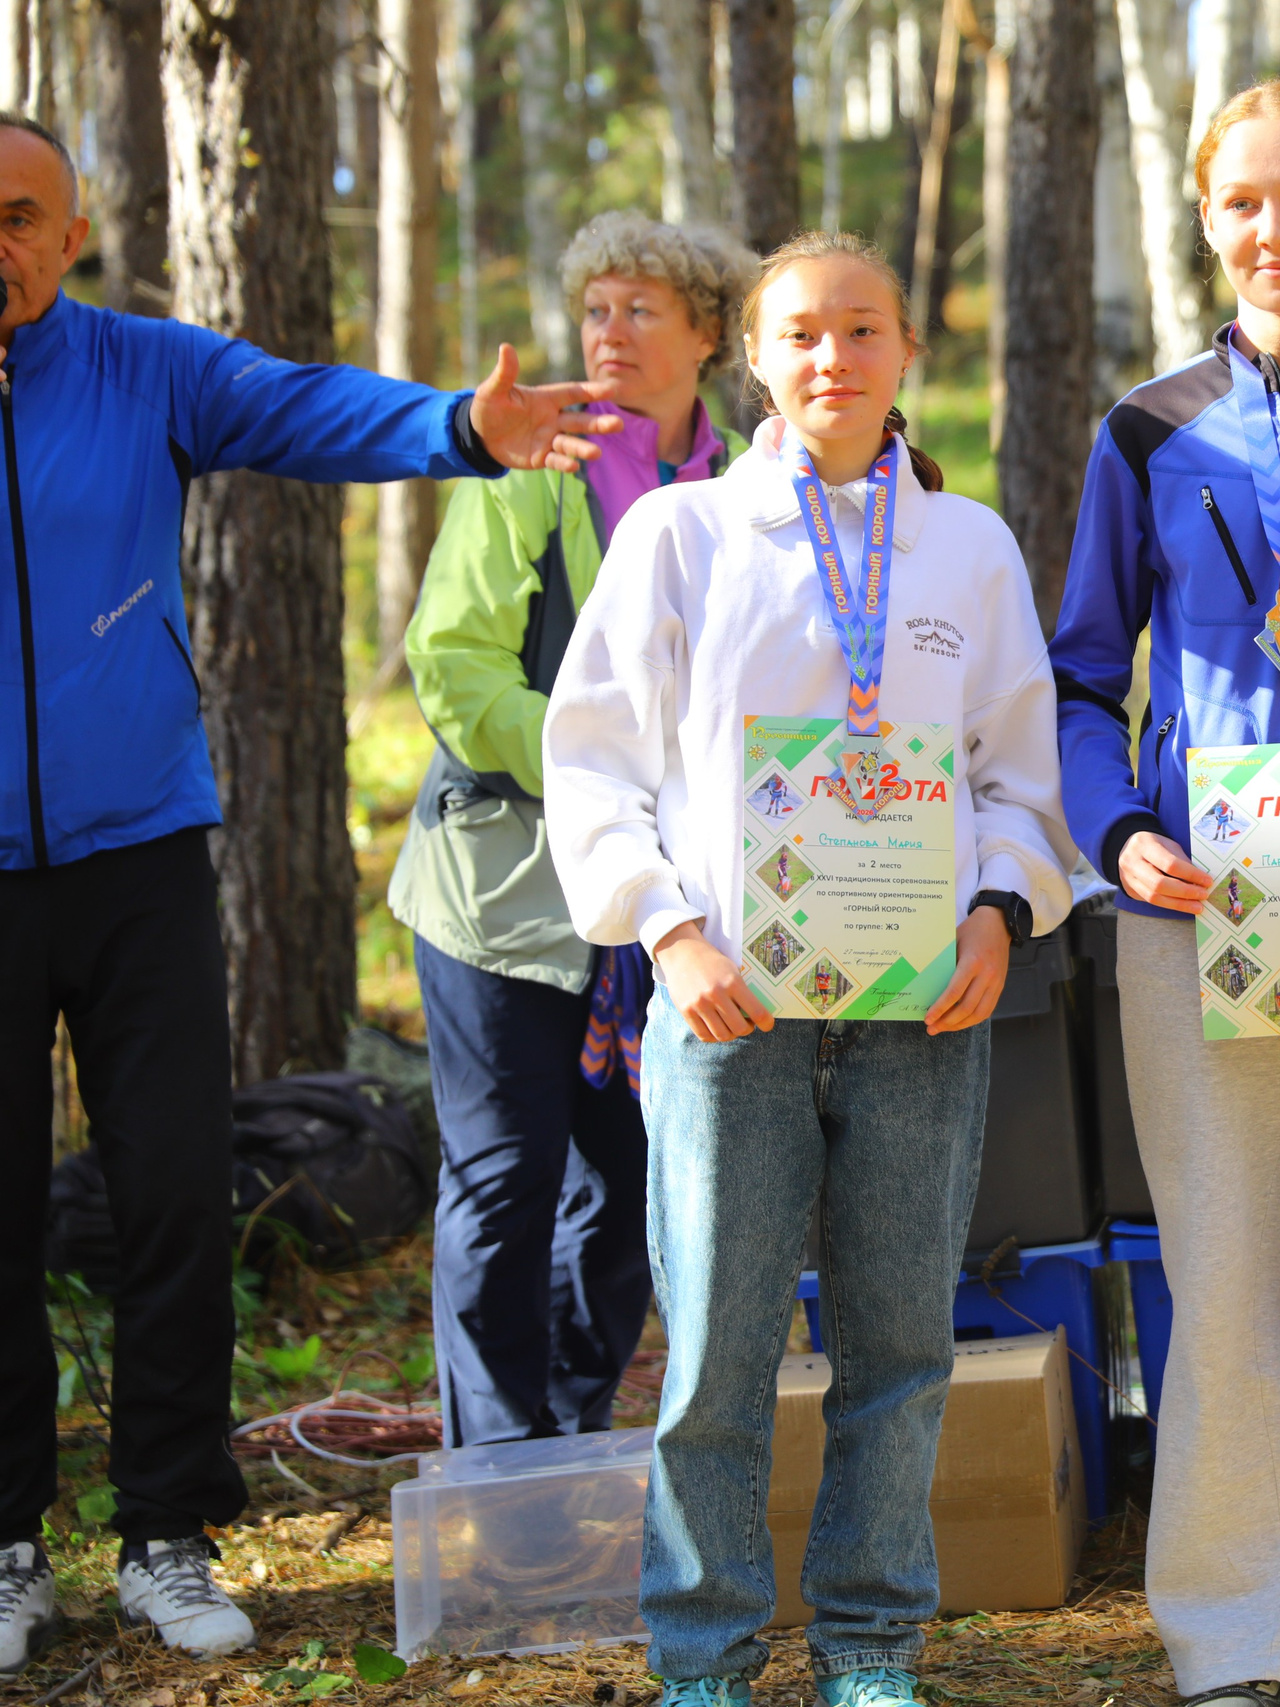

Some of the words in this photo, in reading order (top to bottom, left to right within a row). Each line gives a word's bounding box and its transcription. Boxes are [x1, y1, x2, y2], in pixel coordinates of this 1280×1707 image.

[805, 484, 831, 545] КОРОЛЬ
[871, 485, 888, 546] КОРОЛЬ
[822, 551, 850, 614] ГОРНЫЙ
[865, 551, 883, 615] ГОРНЫЙ
[109, 579, 153, 623] NORD
[905, 617, 931, 630] ROSA
[933, 618, 964, 644] KHUTOR
[913, 643, 927, 652] SKI
[930, 647, 960, 660] RESORT
[879, 763, 898, 787] 2
[873, 782, 905, 811] КОРОЛЬ
[870, 860, 876, 868] 2
[827, 890, 877, 898] спортивному
[843, 904, 880, 912] «ГОРНЫЙ
[881, 905, 917, 913] КОРОЛЬ»
[885, 923, 899, 931] ЖЭ
